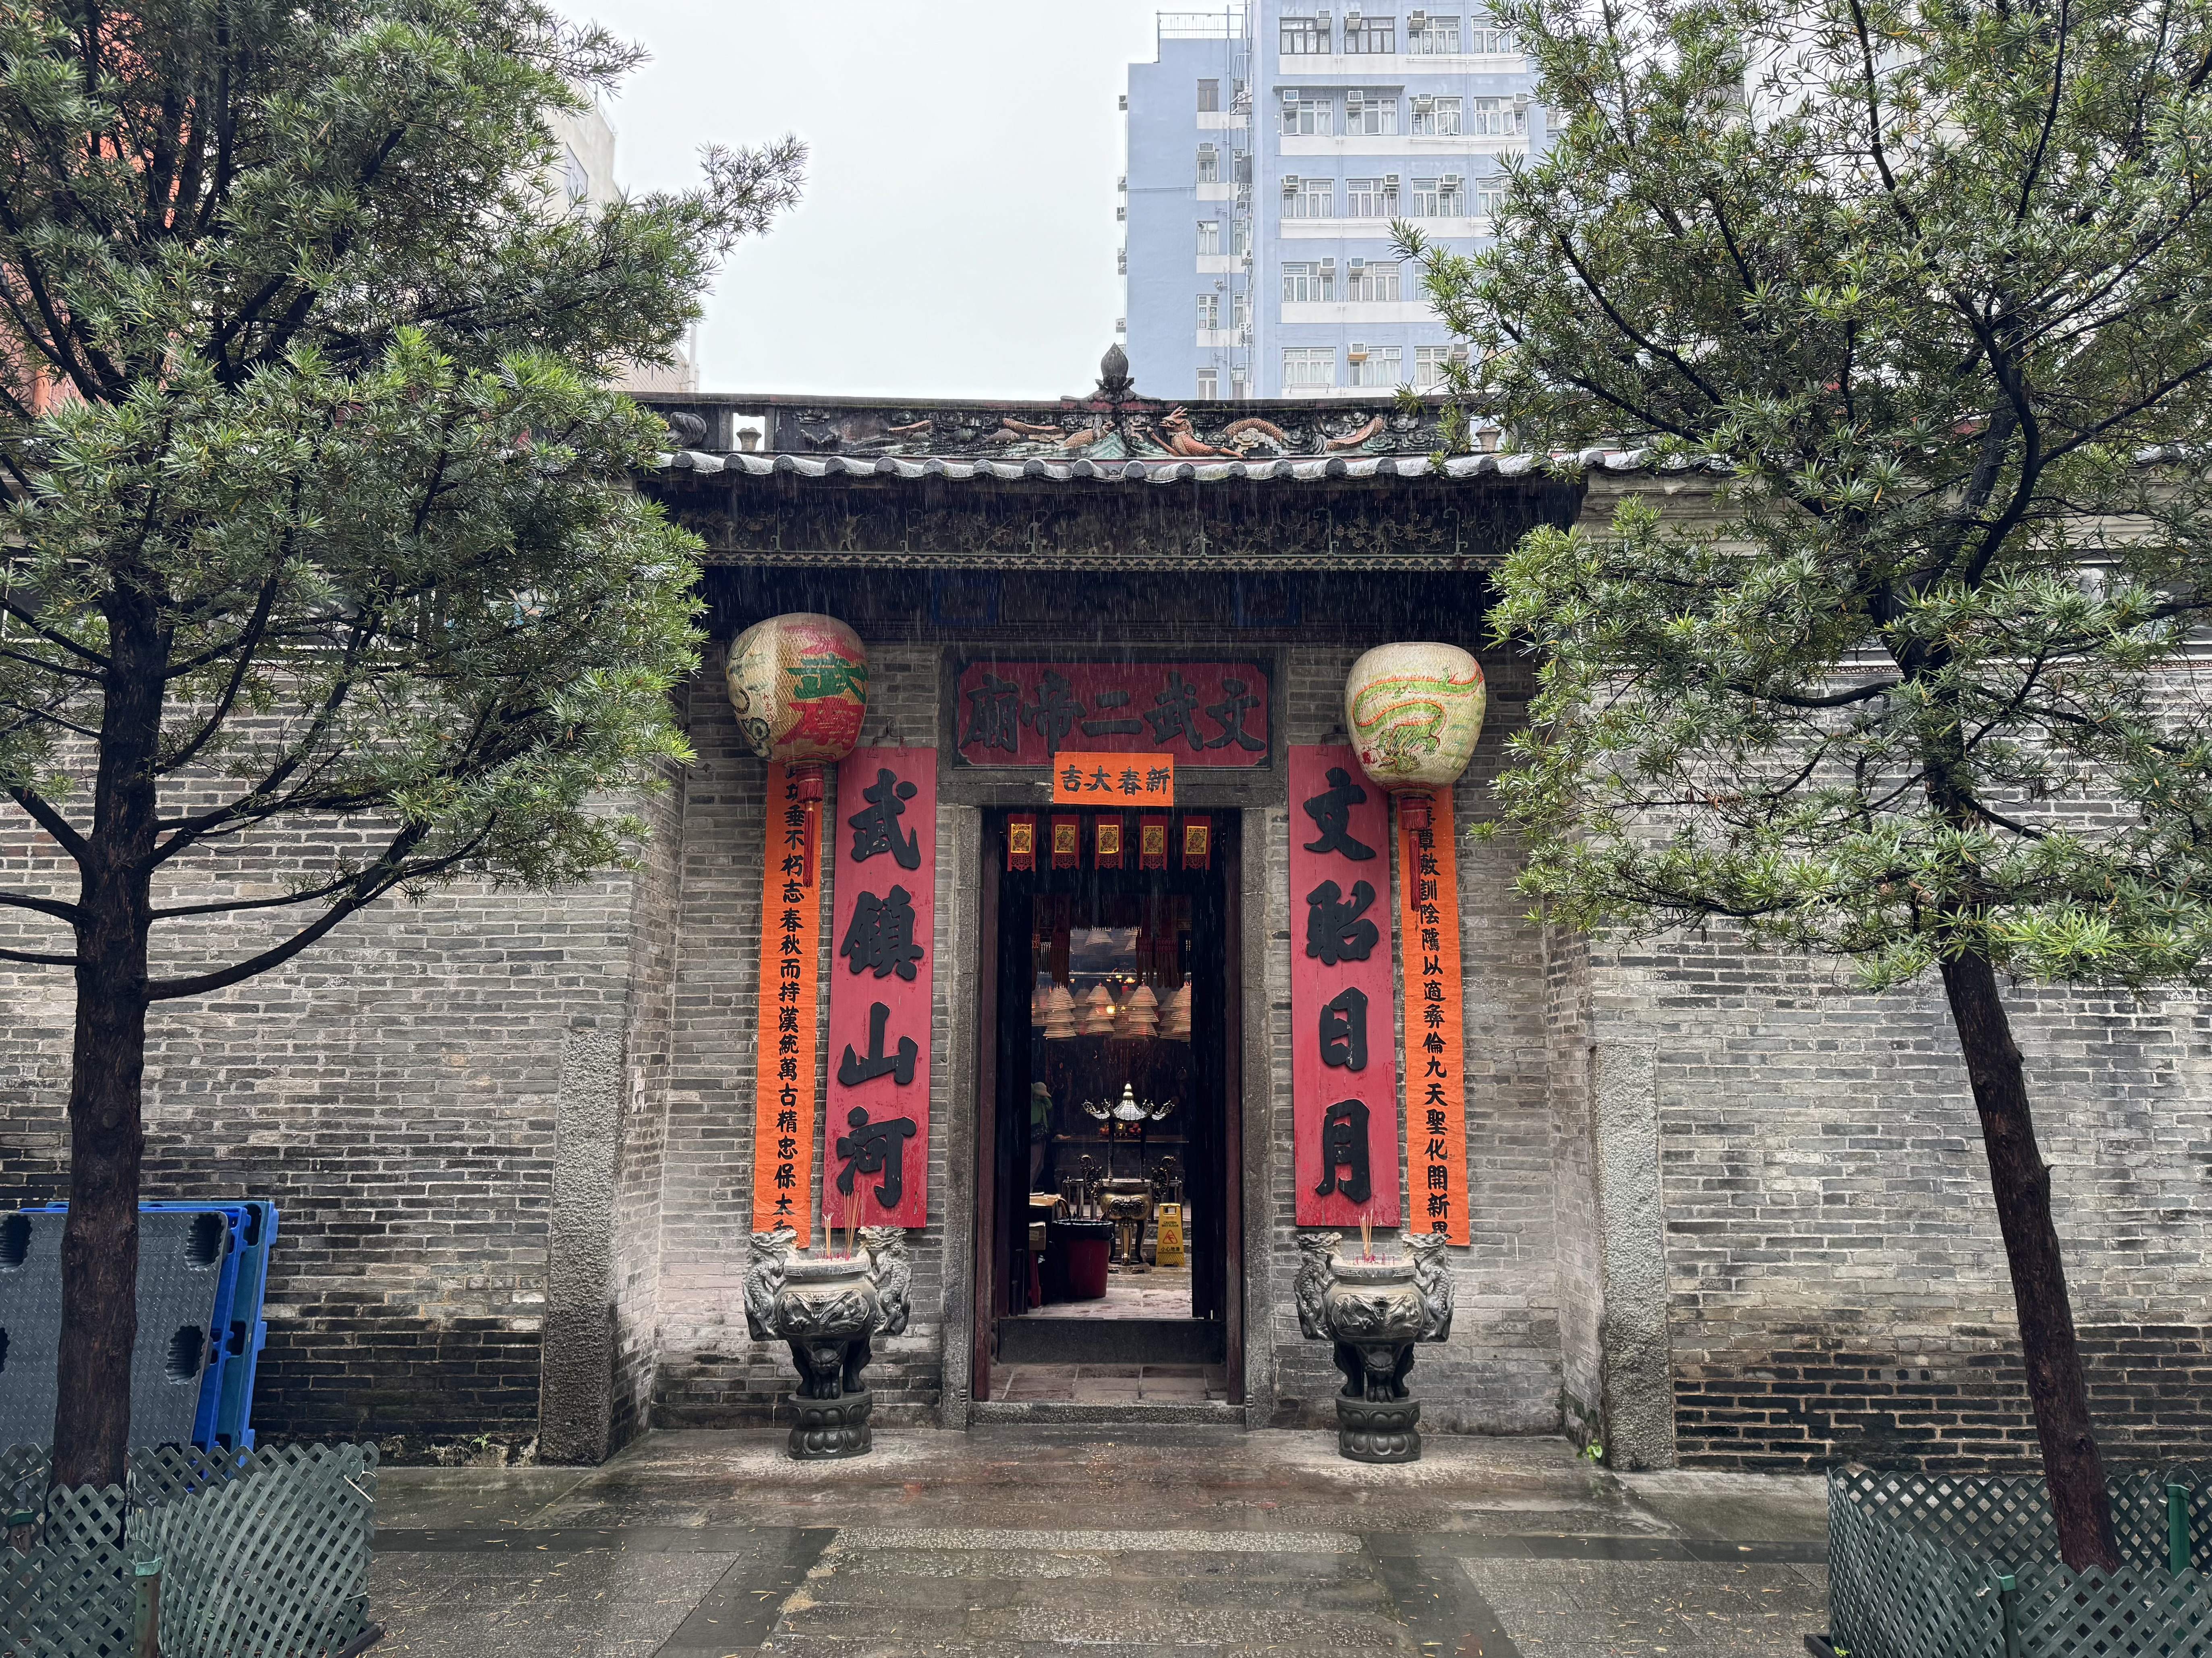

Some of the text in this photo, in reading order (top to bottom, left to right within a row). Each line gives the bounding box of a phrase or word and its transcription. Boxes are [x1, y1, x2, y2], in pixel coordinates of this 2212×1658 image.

[960, 669, 1266, 757] 文武二帝廟
[1059, 764, 1171, 796] 新春大吉
[836, 768, 924, 1207] 武鎮山河
[1303, 767, 1379, 1203] 文昭日月
